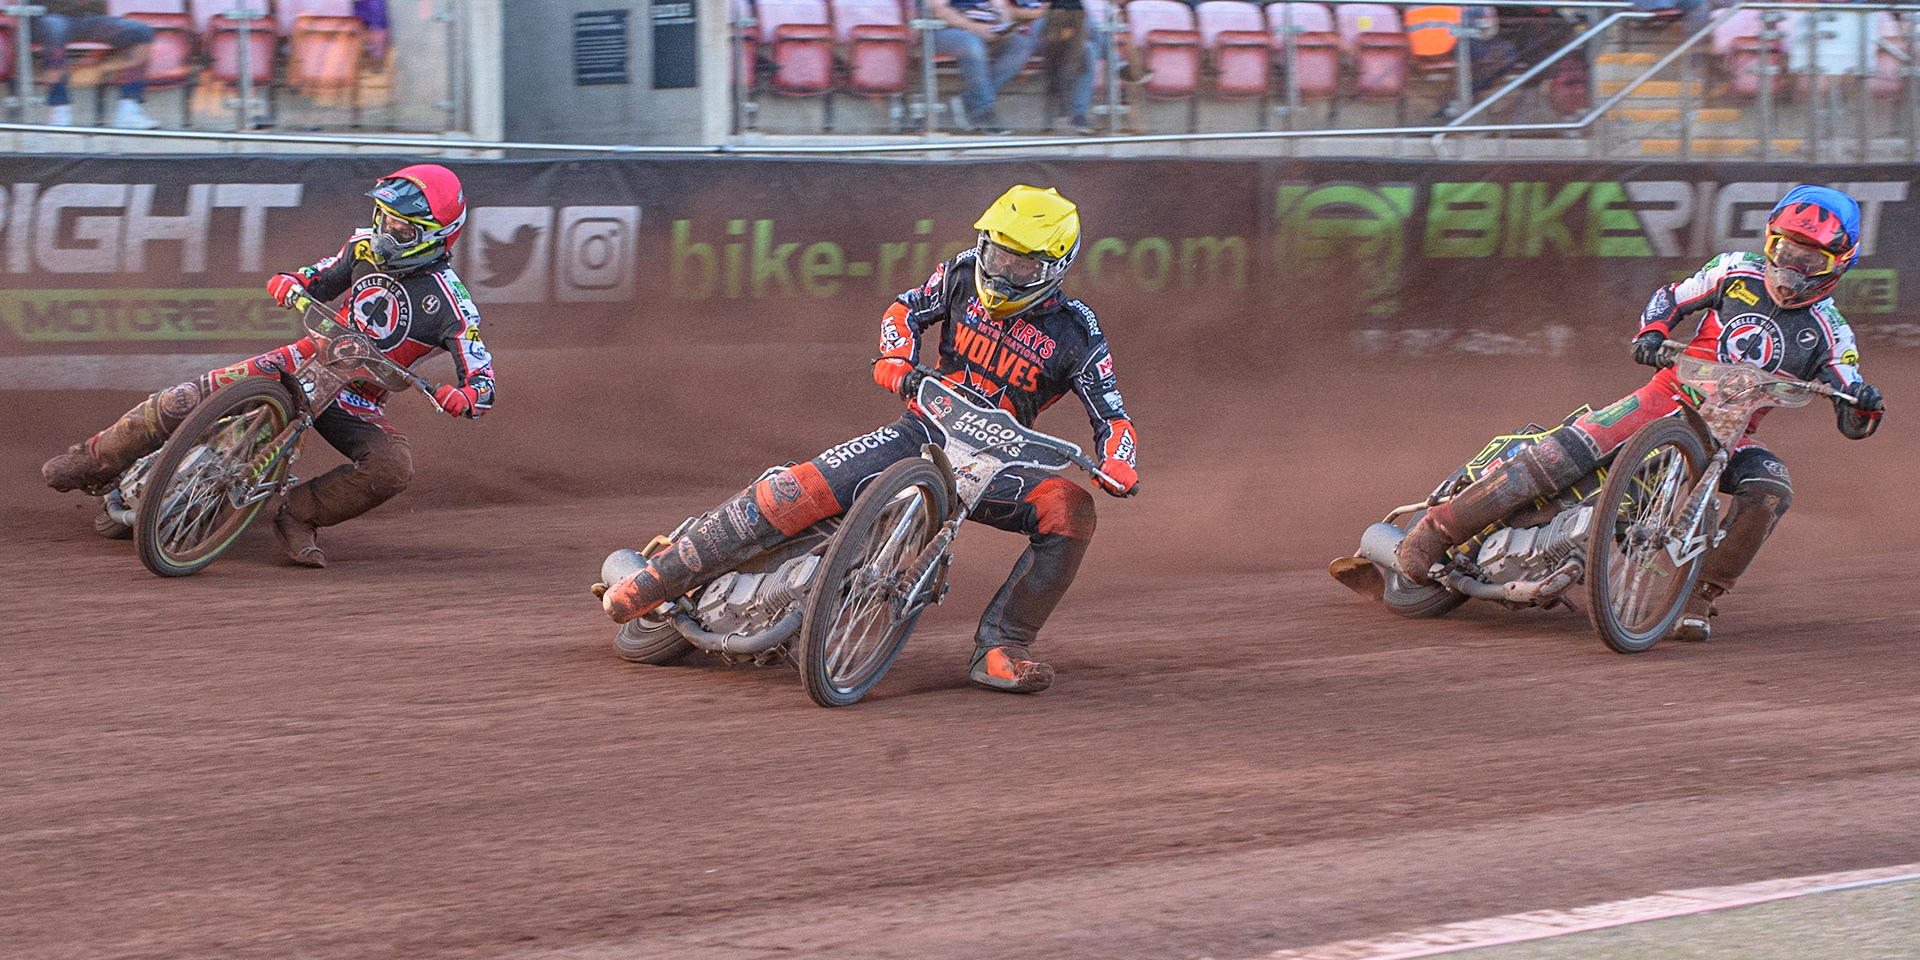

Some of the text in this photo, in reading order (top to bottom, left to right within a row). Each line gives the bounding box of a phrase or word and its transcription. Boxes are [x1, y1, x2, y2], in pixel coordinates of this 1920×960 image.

[0, 183, 303, 273] IGHT
[356, 278, 383, 292] BELLE
[398, 301, 408, 327] ACES
[1730, 317, 1757, 329] BELLE
[954, 321, 1042, 393] WOLVES
[826, 427, 900, 469] SHOCKS
[952, 420, 1021, 458] SHOCKS
[959, 411, 1030, 448] HAGON
